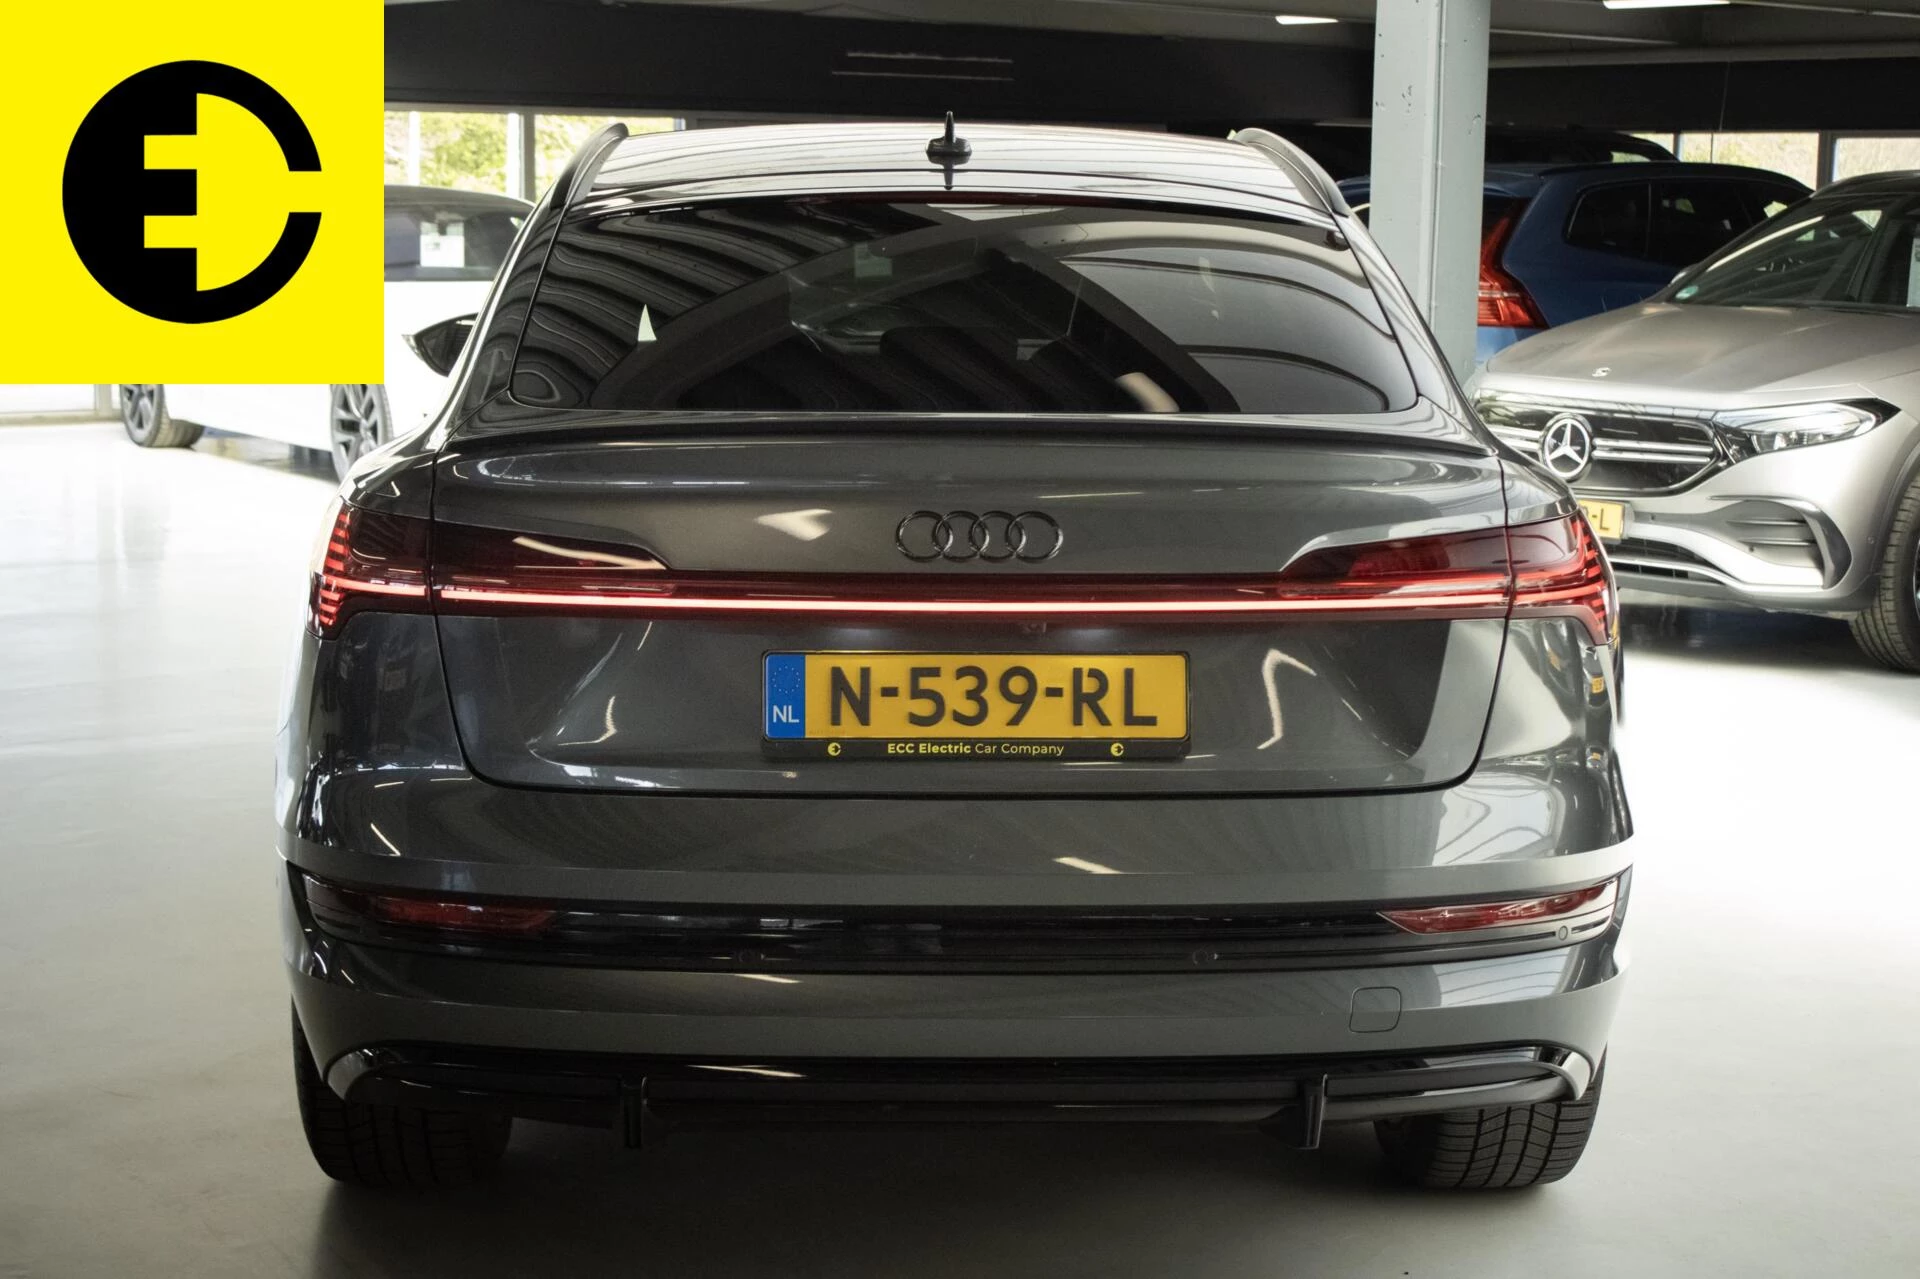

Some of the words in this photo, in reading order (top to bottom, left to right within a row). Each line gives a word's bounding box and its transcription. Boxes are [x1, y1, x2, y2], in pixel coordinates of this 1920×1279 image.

[830, 666, 1158, 727] N-539-RL
[772, 705, 800, 723] NL
[887, 743, 915, 754] ECC
[919, 743, 972, 754] Electric
[975, 743, 997, 754] Car
[1001, 743, 1065, 757] Company
